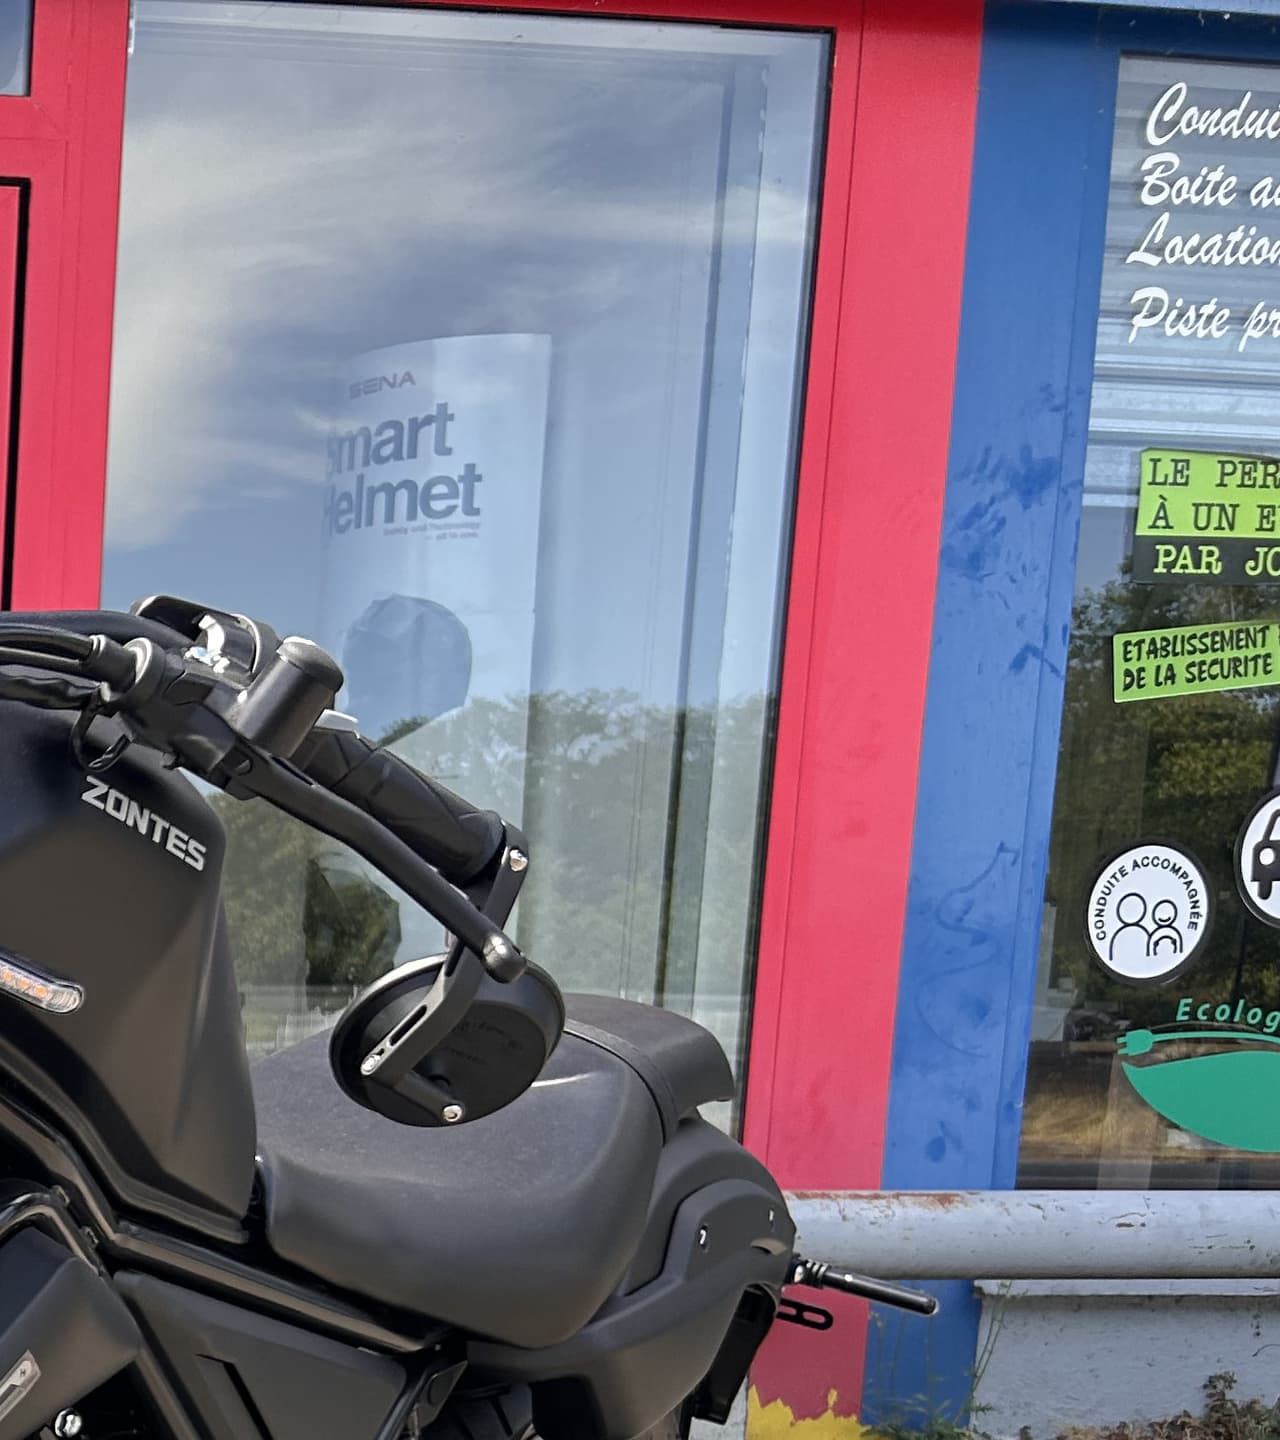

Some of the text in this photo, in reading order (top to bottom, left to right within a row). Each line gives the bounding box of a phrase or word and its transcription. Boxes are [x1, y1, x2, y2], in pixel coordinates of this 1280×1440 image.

[1141, 152, 1237, 206] Boite
[1128, 287, 1231, 343] Piste
[349, 371, 416, 399] SENA
[328, 402, 455, 475] mart
[1147, 458, 1190, 487] LE
[1148, 494, 1174, 529] À
[1192, 503, 1240, 531] UN
[1153, 544, 1222, 574] PAR
[1122, 626, 1270, 662] ETABLISSEMENT
[1123, 652, 1272, 691] DE LA SECURITE
[82, 775, 207, 871] ZONTES
[1094, 856, 1203, 940] CONDUITE ACCOMPAGNÉE
[1176, 998, 1280, 1033] Ecolog
